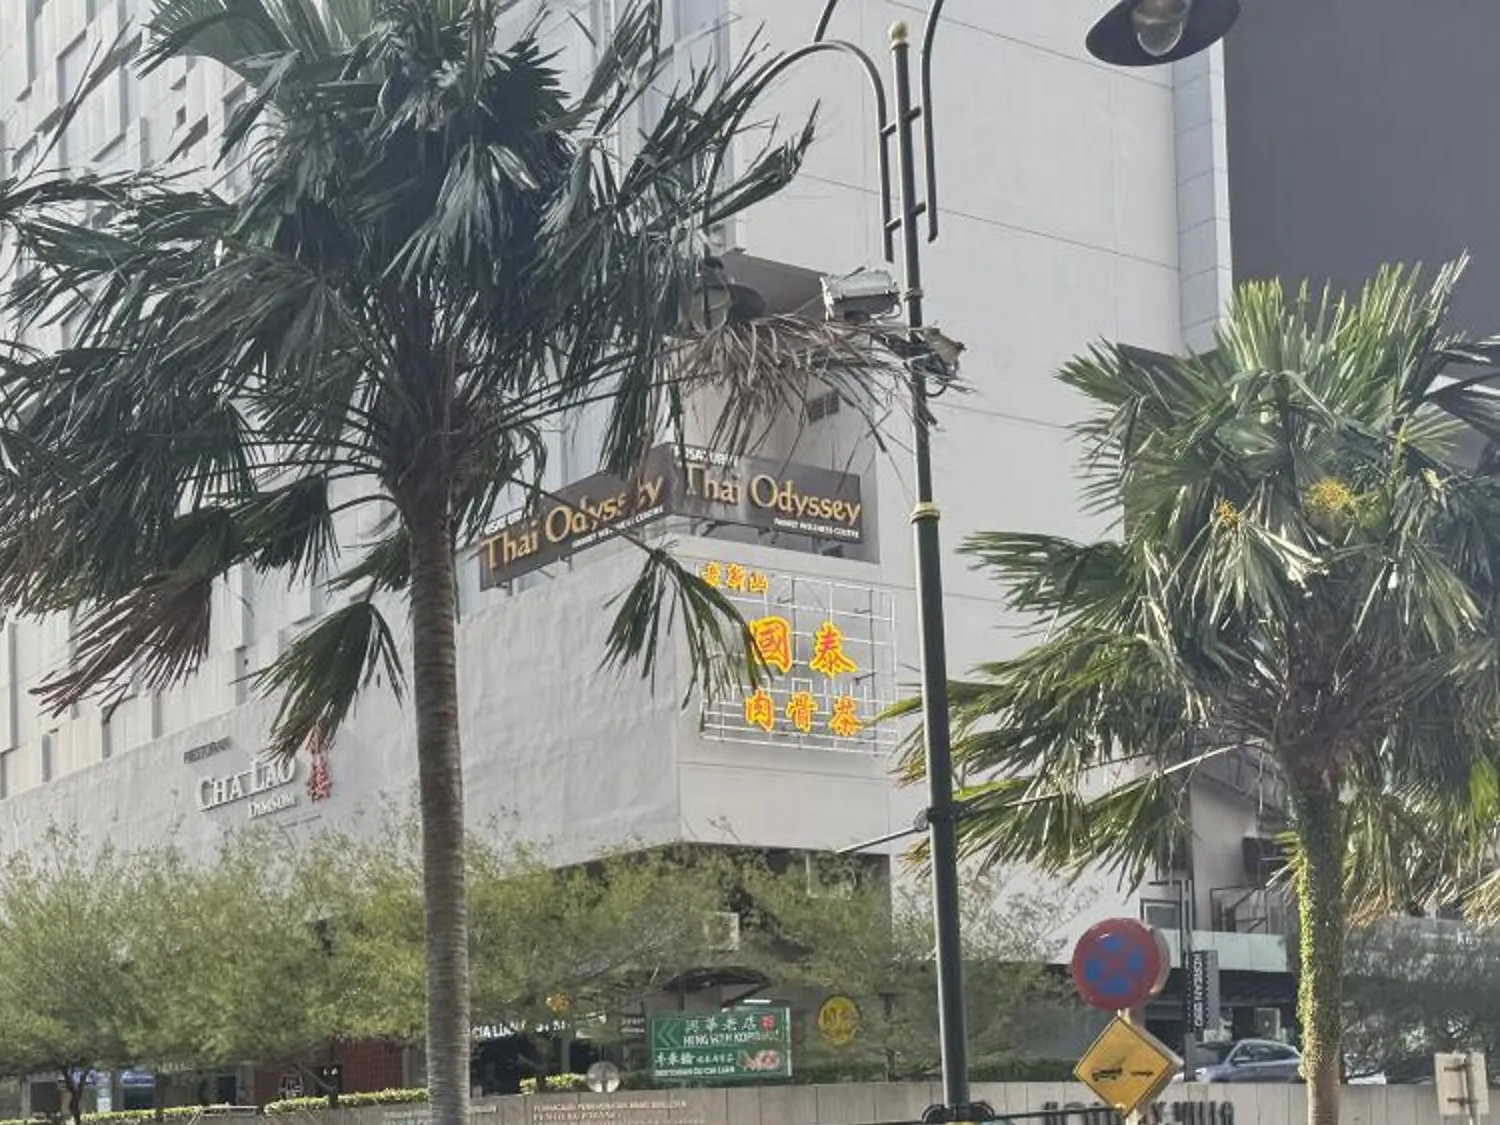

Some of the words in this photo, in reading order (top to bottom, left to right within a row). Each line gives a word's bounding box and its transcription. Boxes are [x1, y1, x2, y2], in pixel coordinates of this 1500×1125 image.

[686, 462, 742, 505] Thai
[751, 474, 861, 525] Odyssey
[483, 520, 539, 569] Thai
[197, 773, 244, 812] CHA
